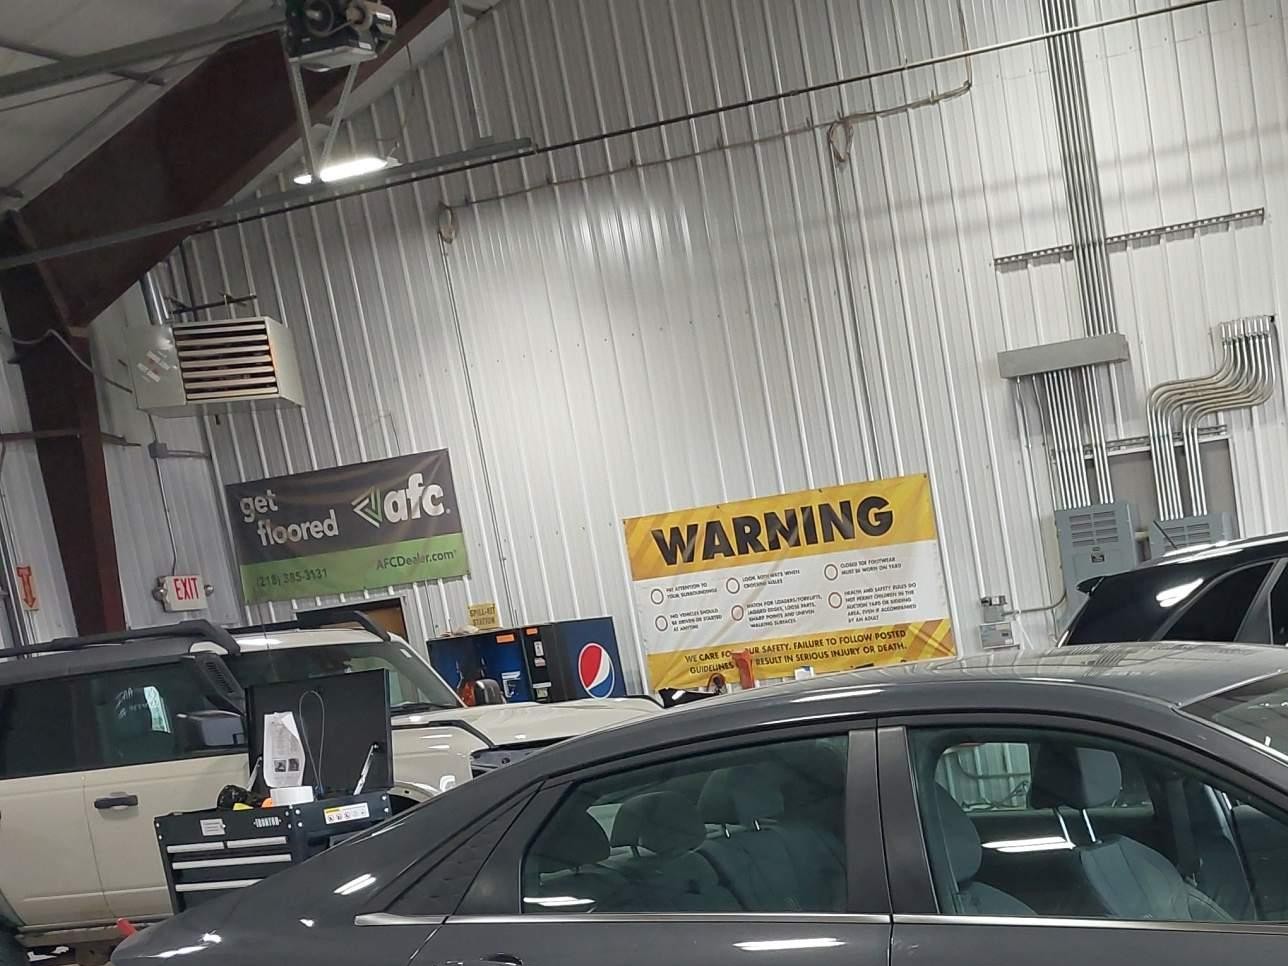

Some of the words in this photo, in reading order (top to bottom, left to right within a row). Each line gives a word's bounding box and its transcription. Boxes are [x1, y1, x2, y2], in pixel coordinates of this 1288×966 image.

[239, 488, 279, 523] get
[257, 508, 339, 546] floored
[651, 495, 894, 566] WARNING
[173, 577, 200, 601] EXIT
[684, 654, 698, 663] WE
[698, 652, 719, 661] CARE
[793, 639, 824, 650] FAILURE
[825, 637, 837, 646] TO
[839, 634, 873, 645] FOLLOW
[874, 629, 906, 641] POSTED
[689, 661, 735, 674] GUIDELINES
[756, 655, 783, 665] RESULT
[784, 654, 794, 662] IN
[795, 650, 829, 662] SERIOUS
[830, 647, 860, 657] INJURY
[862, 645, 876, 654] OR
